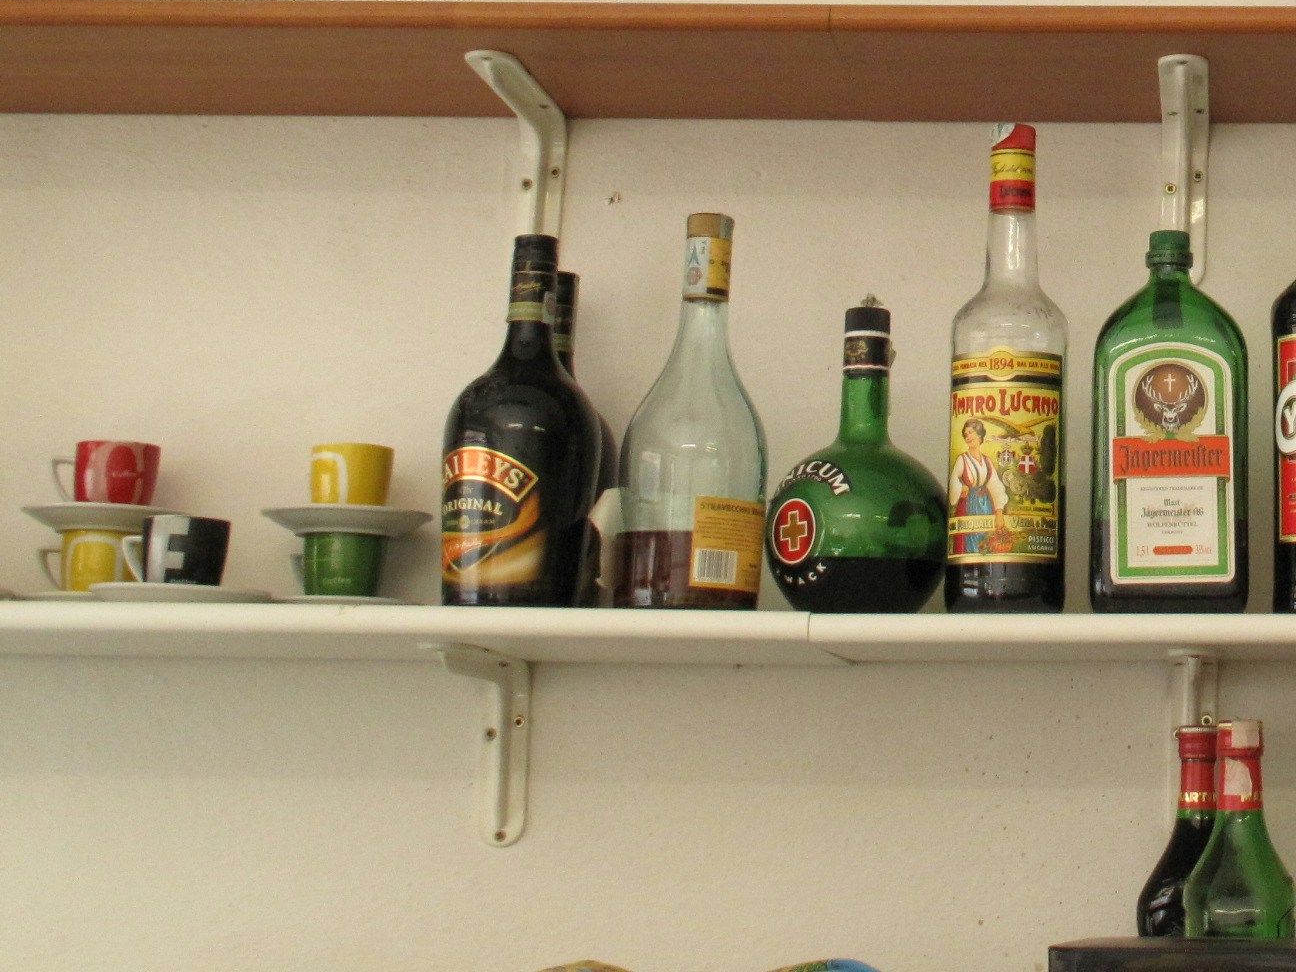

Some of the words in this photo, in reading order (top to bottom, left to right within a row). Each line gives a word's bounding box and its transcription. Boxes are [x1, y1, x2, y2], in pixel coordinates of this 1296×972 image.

[989, 358, 1014, 370] 1894
[952, 393, 996, 418] AMARO
[999, 389, 1059, 416] LUCANO
[443, 452, 525, 489] AILEYS
